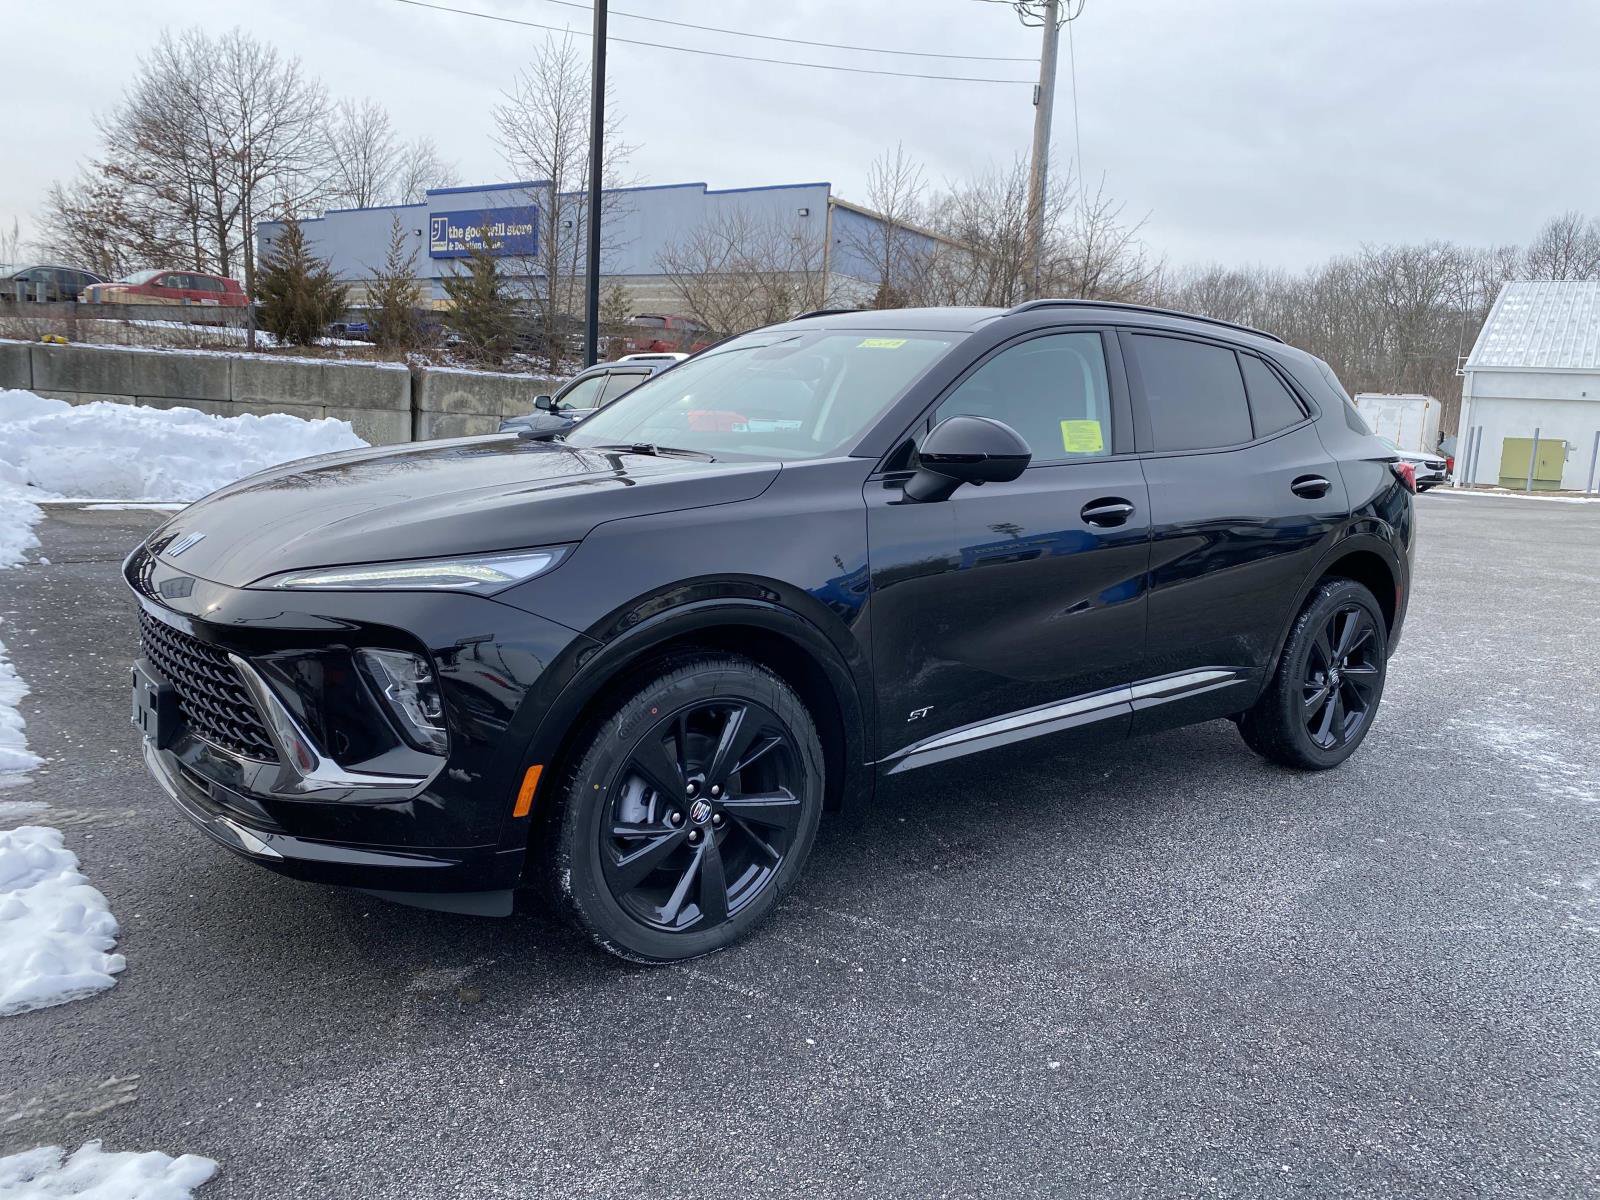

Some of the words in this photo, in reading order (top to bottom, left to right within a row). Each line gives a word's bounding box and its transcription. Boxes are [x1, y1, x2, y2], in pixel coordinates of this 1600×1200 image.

[448, 225, 463, 238] the
[464, 222, 505, 240] goowill
[506, 223, 533, 236] store
[907, 705, 935, 722] ST
